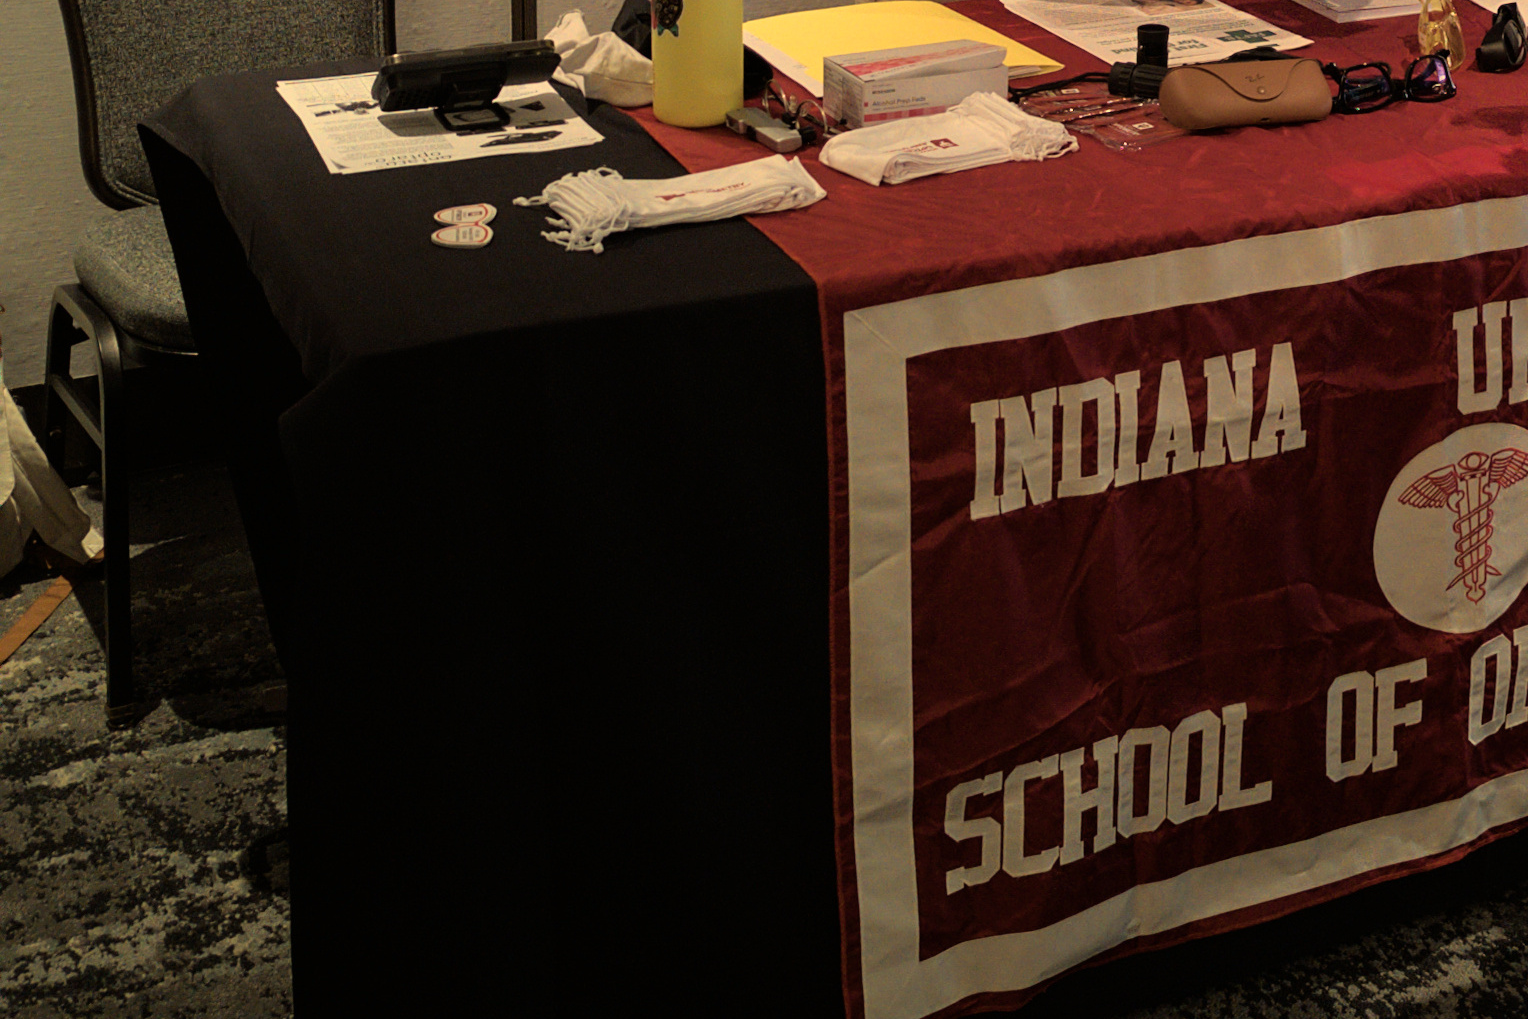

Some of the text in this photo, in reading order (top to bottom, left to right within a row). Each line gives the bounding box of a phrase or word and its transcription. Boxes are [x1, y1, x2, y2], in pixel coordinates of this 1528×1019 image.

[969, 342, 1307, 521] INDIANA
[944, 702, 1272, 896] SCHOOL
[1325, 659, 1429, 783] OF
